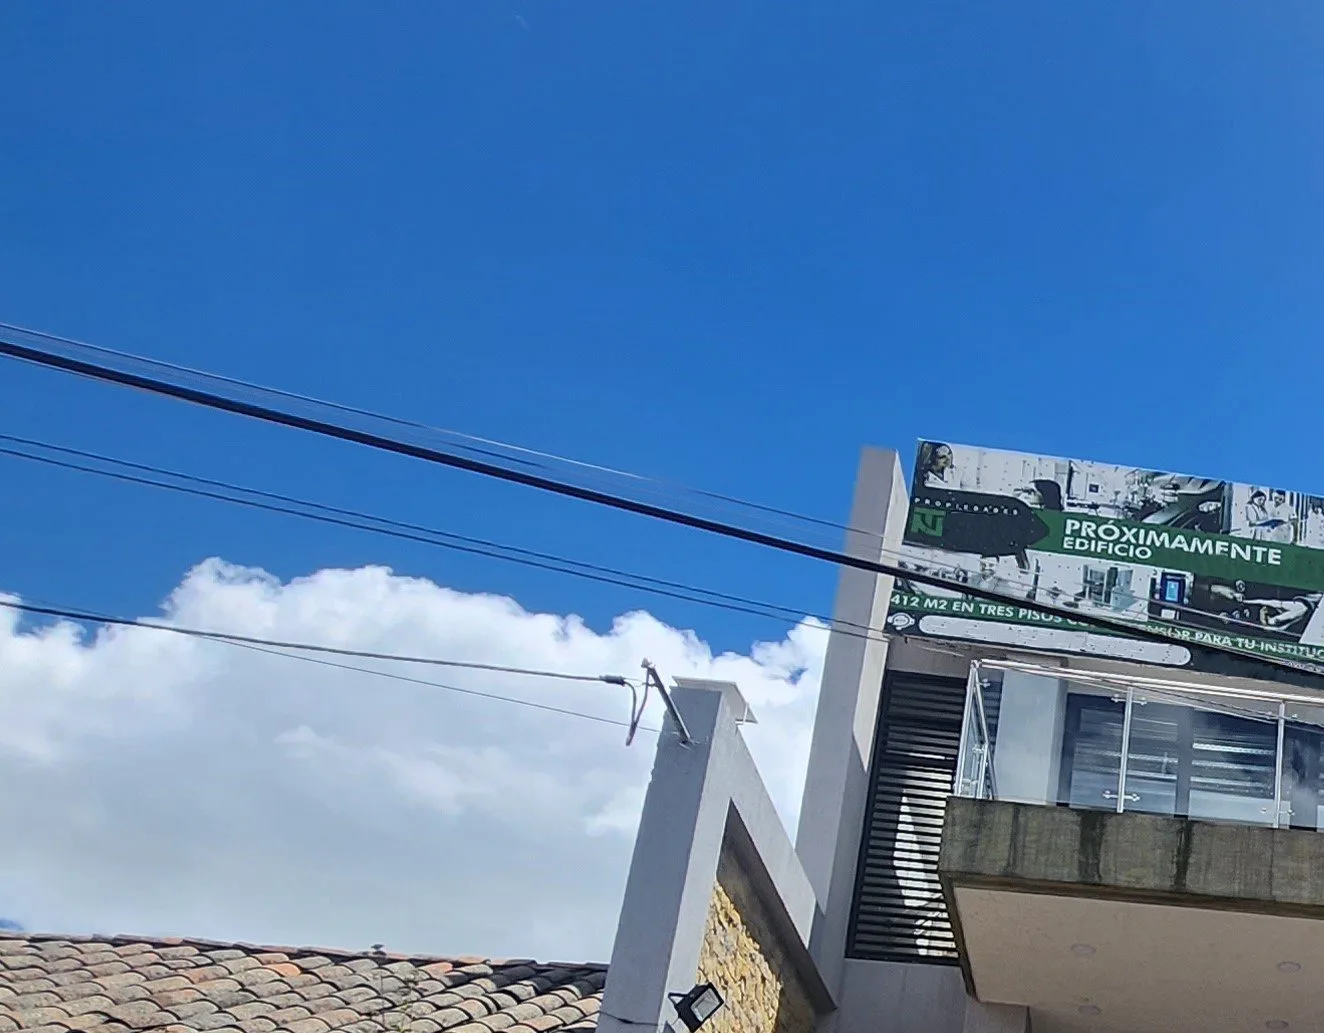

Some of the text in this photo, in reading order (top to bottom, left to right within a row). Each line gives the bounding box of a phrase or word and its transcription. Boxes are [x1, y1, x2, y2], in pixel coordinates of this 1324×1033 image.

[914, 497, 1018, 515] PROPIEDADES
[1063, 537, 1152, 559] EDIFICIO
[1065, 519, 1281, 566] PRÓXIMAMENTE
[891, 594, 920, 608] 412
[923, 598, 947, 610] M2
[952, 601, 974, 613] EN
[979, 604, 1014, 617] TRES
[1018, 608, 1063, 624] PISOS
[1195, 631, 1233, 647] PARA
[1235, 637, 1256, 649] TU
